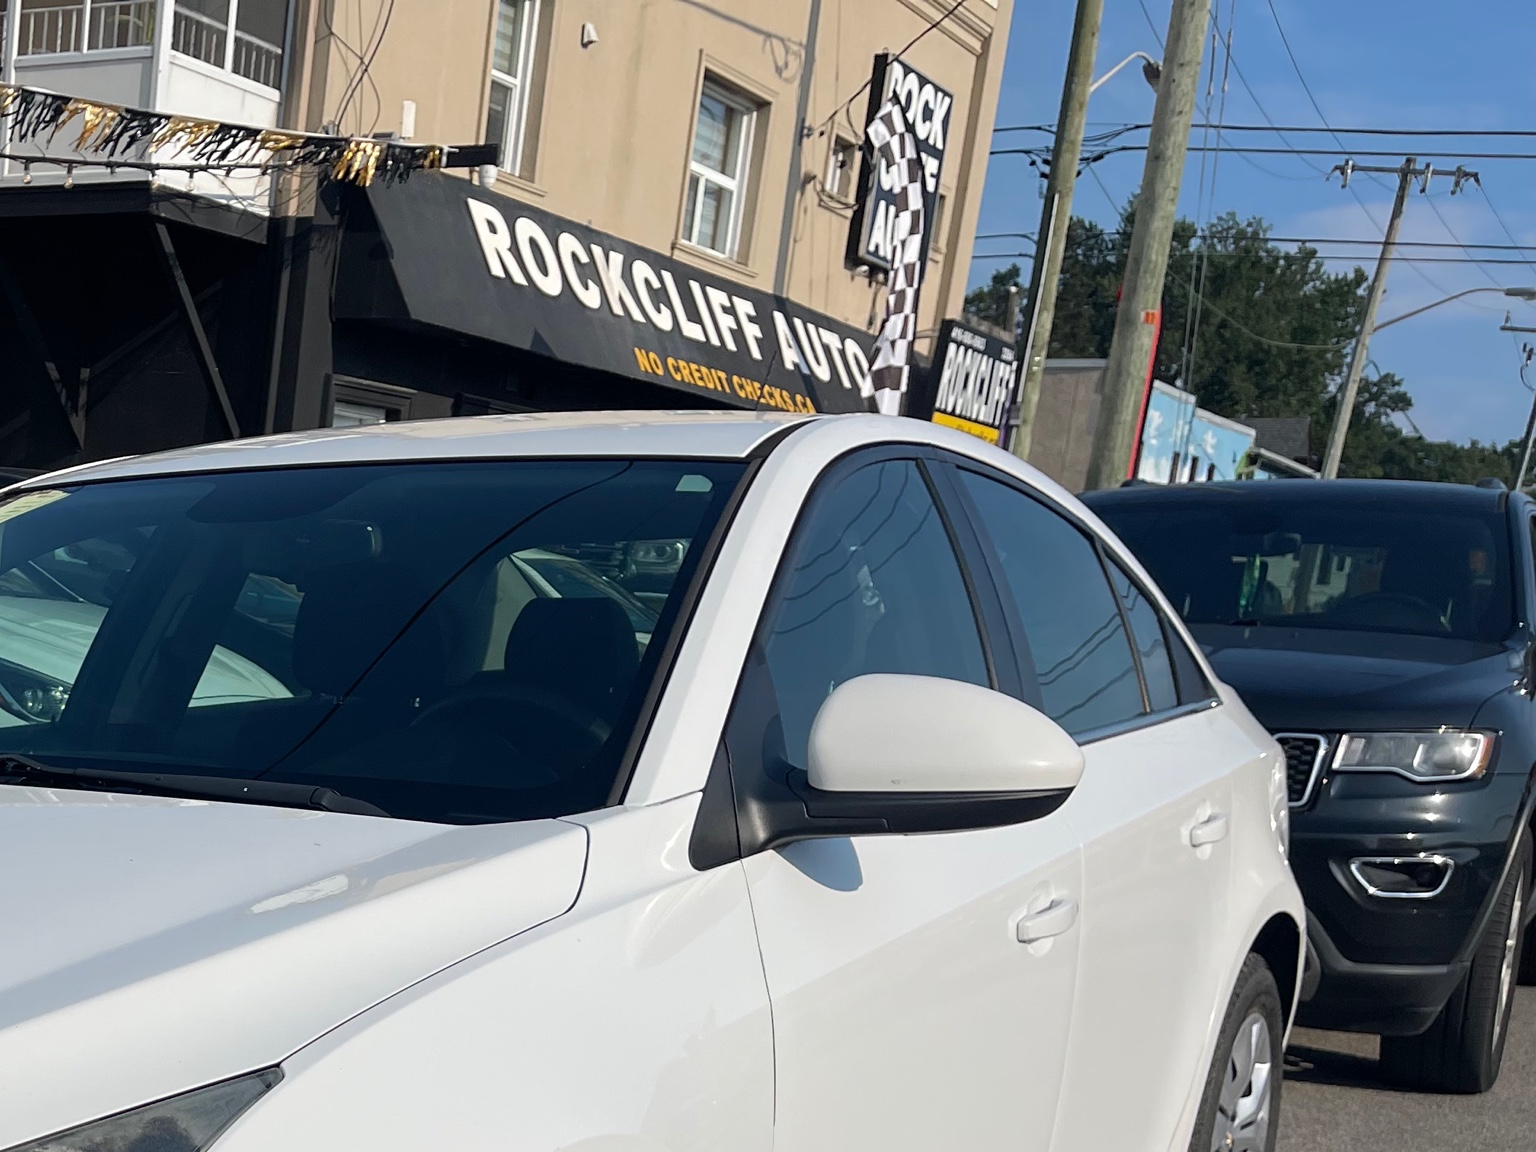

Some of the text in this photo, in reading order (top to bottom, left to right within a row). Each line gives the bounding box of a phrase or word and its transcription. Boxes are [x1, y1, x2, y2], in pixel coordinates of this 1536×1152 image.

[466, 197, 873, 400] ROCKCLIFF AUTO
[634, 347, 664, 377] NO
[666, 356, 731, 394] CREDIT
